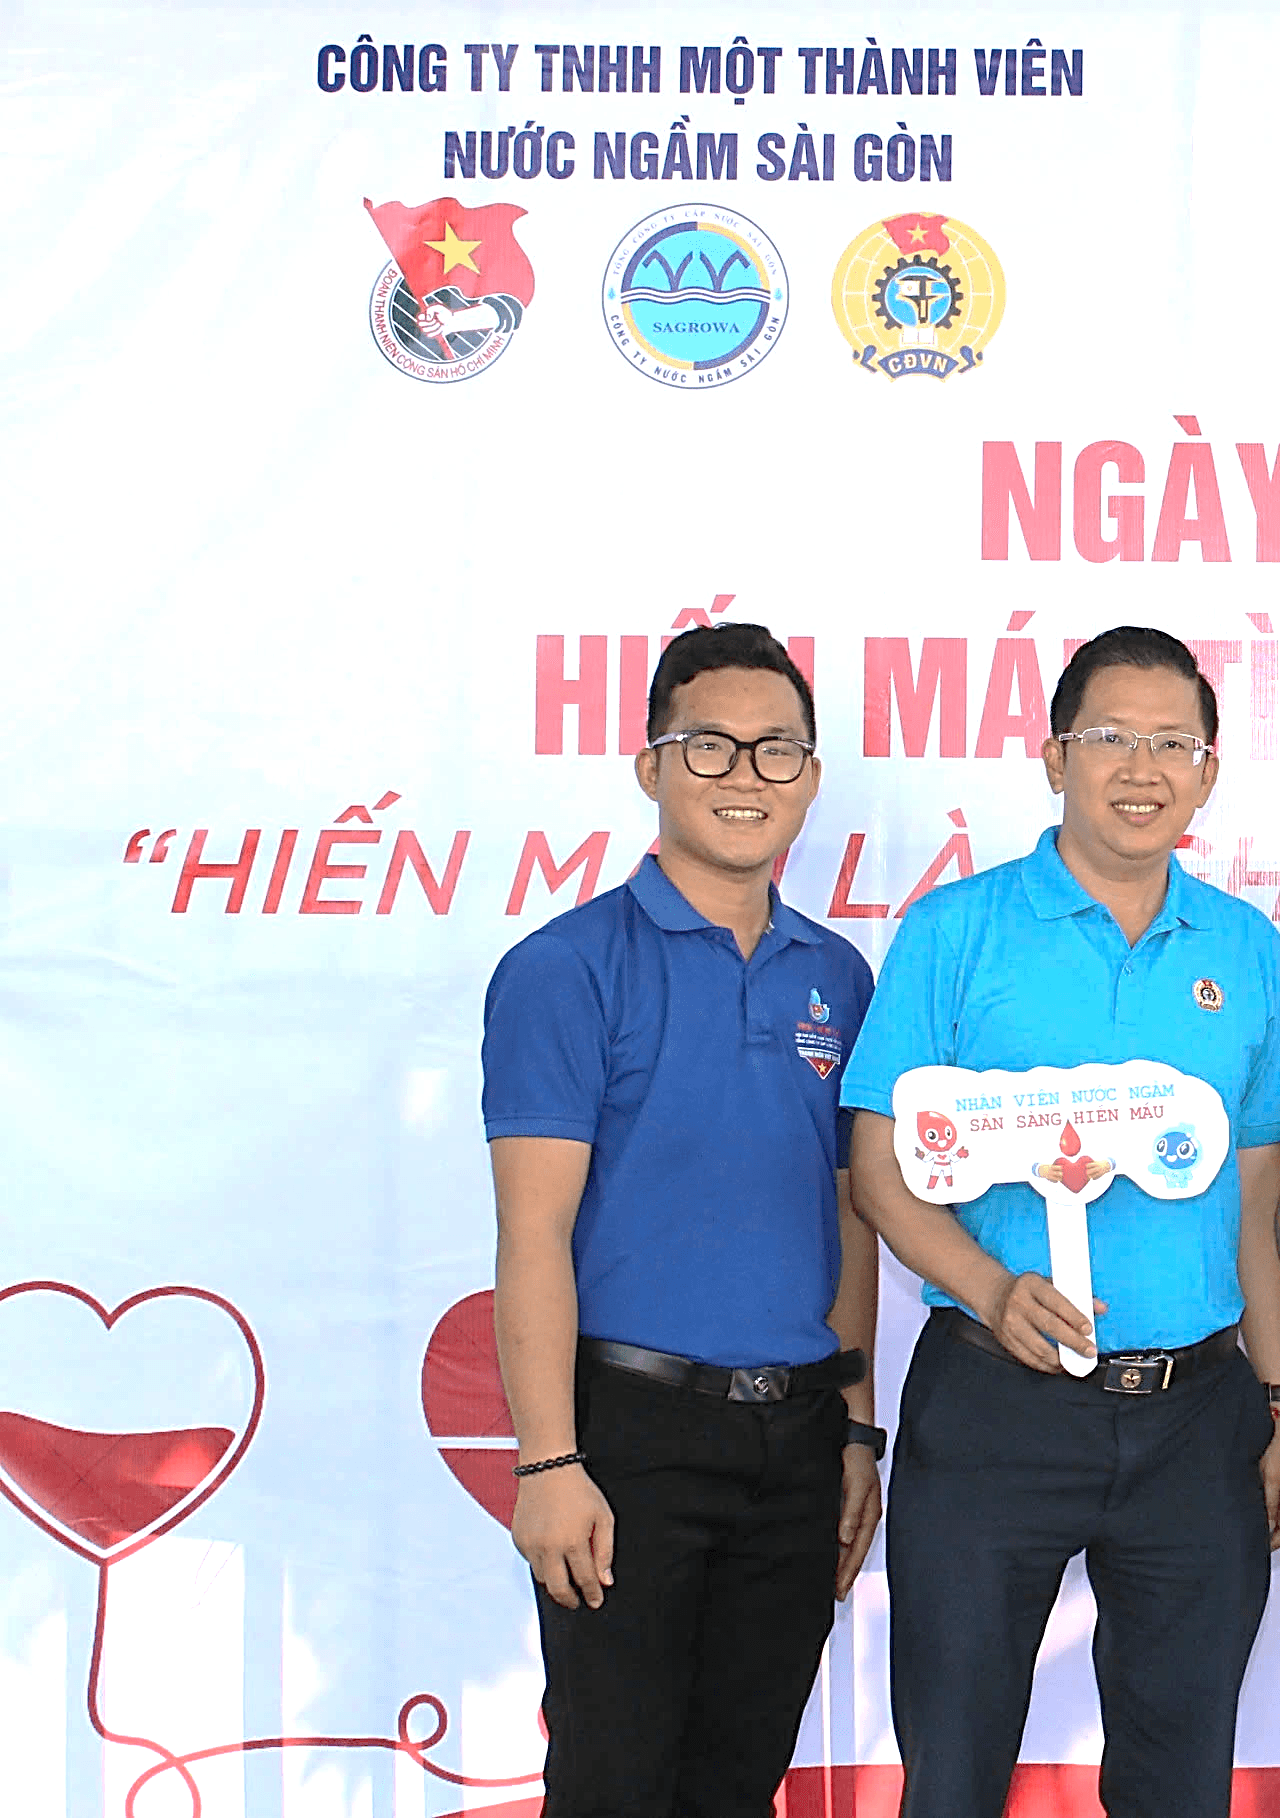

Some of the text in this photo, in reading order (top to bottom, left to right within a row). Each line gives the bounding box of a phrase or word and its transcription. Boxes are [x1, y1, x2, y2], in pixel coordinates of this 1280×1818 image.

[317, 34, 1084, 105] CÔNG TY TNHH MỘT THÀNH VIÊN
[444, 115, 953, 181] NƯỚC NGẦM SÀI GÒN
[374, 300, 388, 334] THANH
[652, 321, 741, 334] SAGROWA
[380, 332, 400, 359] NIÊN
[481, 334, 506, 361] MINH
[633, 350, 648, 366] TY
[888, 353, 948, 373] CĐVN
[534, 594, 815, 756] HI
[863, 610, 1090, 759] MÁ
[123, 790, 472, 915] “HIẾN
[827, 808, 976, 919] LÀ
[955, 1093, 1002, 1112] NHÂN
[1012, 1088, 1060, 1107] VIÊN
[1071, 1085, 1118, 1103] NƯỚC
[1016, 1111, 1062, 1128] SÀNG
[1073, 1105, 1119, 1124] HIẾN
[1129, 1102, 1164, 1120] MÁU
